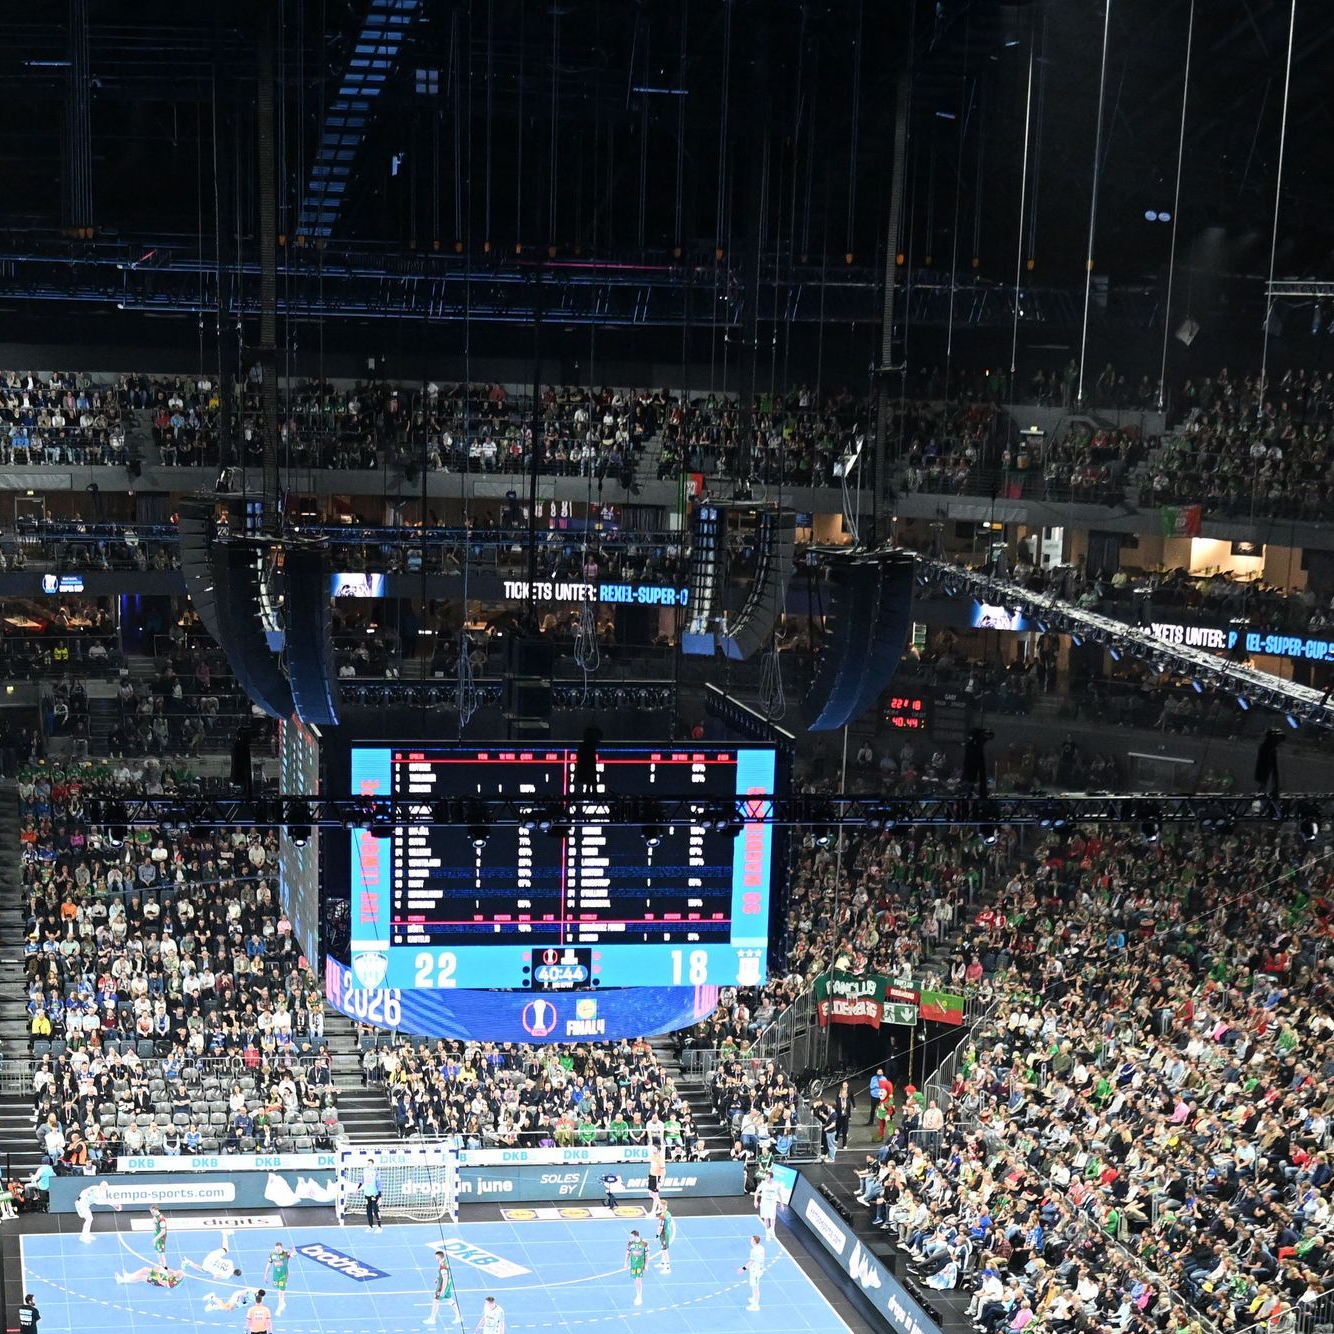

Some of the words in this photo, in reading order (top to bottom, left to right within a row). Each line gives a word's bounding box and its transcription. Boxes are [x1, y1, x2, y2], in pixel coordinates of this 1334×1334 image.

[1186, 626, 1226, 649] UNTER:
[414, 952, 457, 989] 22
[671, 949, 708, 986] 18
[537, 965, 584, 981] 40:44
[343, 970, 402, 1026] 2026
[502, 1151, 528, 1161] DKB
[563, 1150, 589, 1160] DKB
[624, 1148, 649, 1158] DKB
[128, 1157, 155, 1169] DKB
[192, 1157, 218, 1168] DKB
[255, 1156, 282, 1167] DKB
[317, 1155, 335, 1166] DK
[540, 1172, 580, 1185] SOLES
[477, 1177, 513, 1195] june
[559, 1184, 578, 1196] BY
[105, 1185, 225, 1201] kempa-sports.com
[202, 1217, 269, 1228] digits
[439, 1241, 500, 1266] DKB
[301, 1245, 378, 1278] brother
